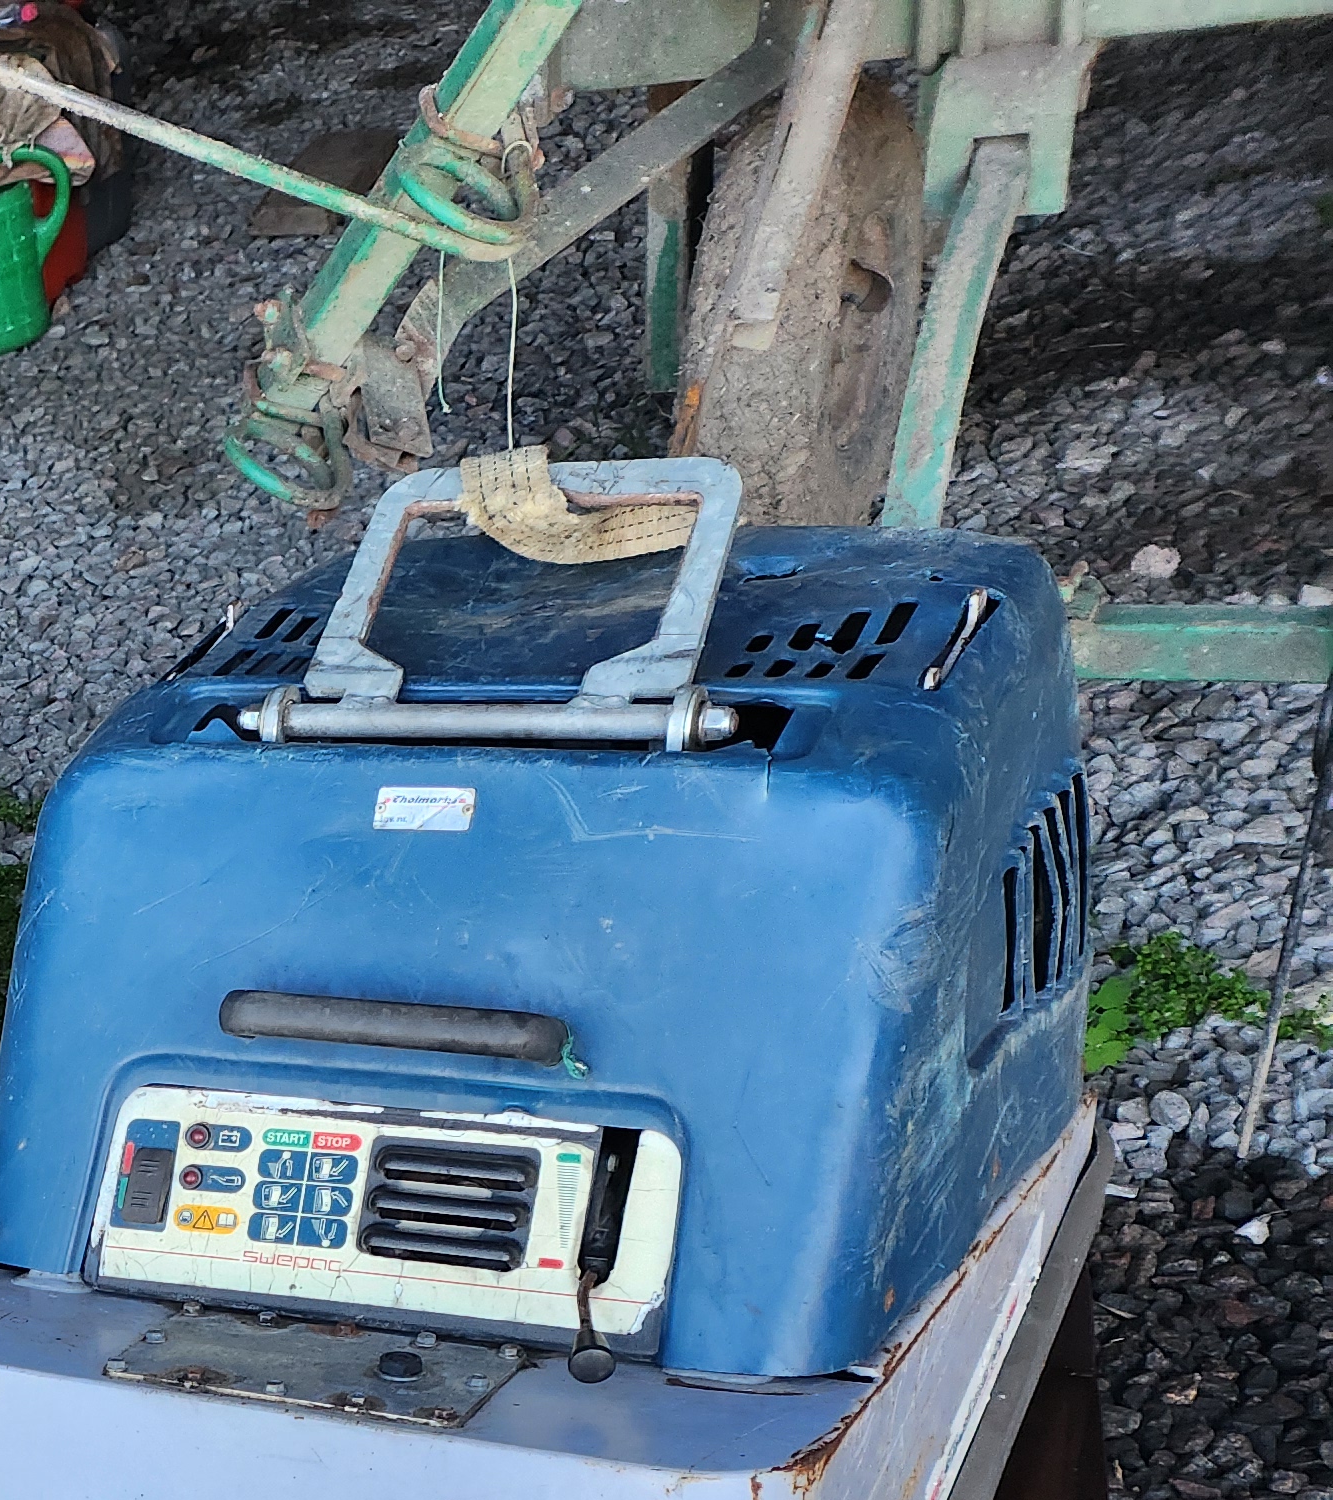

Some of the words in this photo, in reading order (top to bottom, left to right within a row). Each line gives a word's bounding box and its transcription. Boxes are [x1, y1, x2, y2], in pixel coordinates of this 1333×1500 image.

[266, 1132, 307, 1145] START
[317, 1135, 352, 1148] STOP
[242, 1251, 344, 1272] swepac
